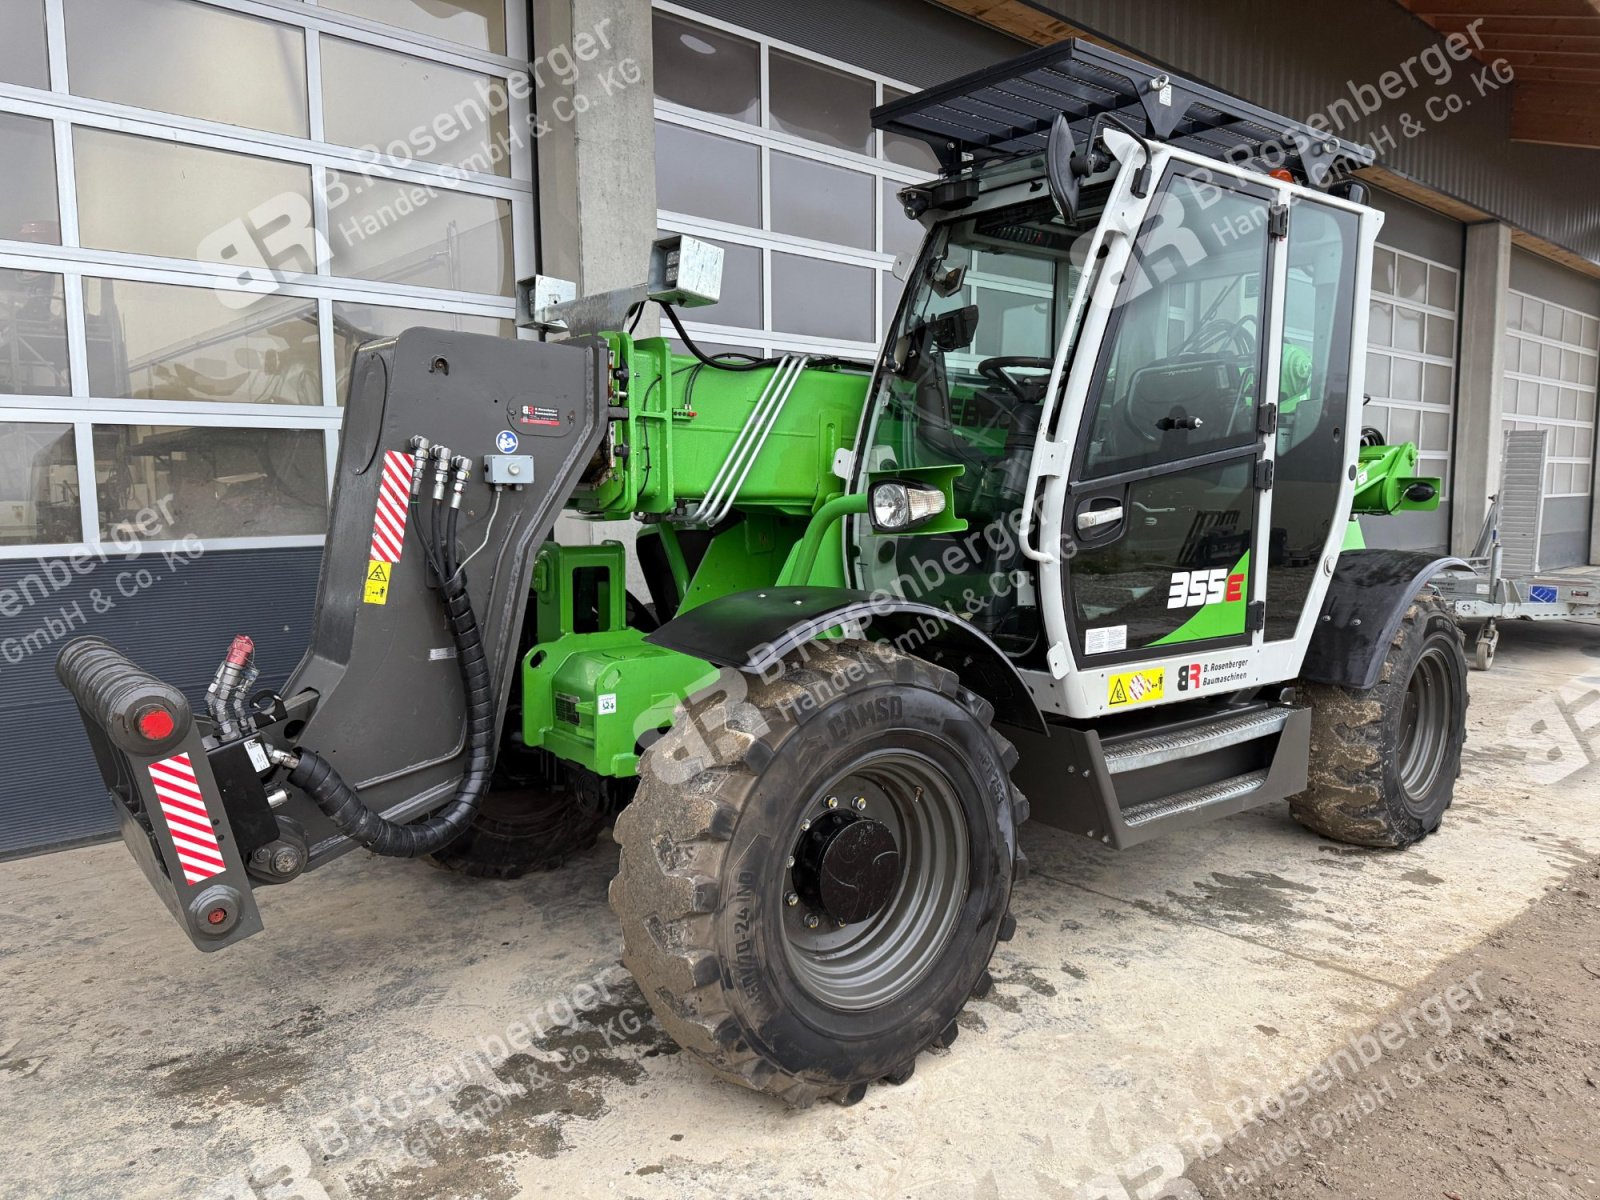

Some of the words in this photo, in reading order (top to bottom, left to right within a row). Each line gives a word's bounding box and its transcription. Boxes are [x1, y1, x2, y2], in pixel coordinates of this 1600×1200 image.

[1167, 568, 1244, 609] 355E
[1210, 659, 1248, 673] Rosenberger
[1202, 672, 1247, 686] Baumaschinen
